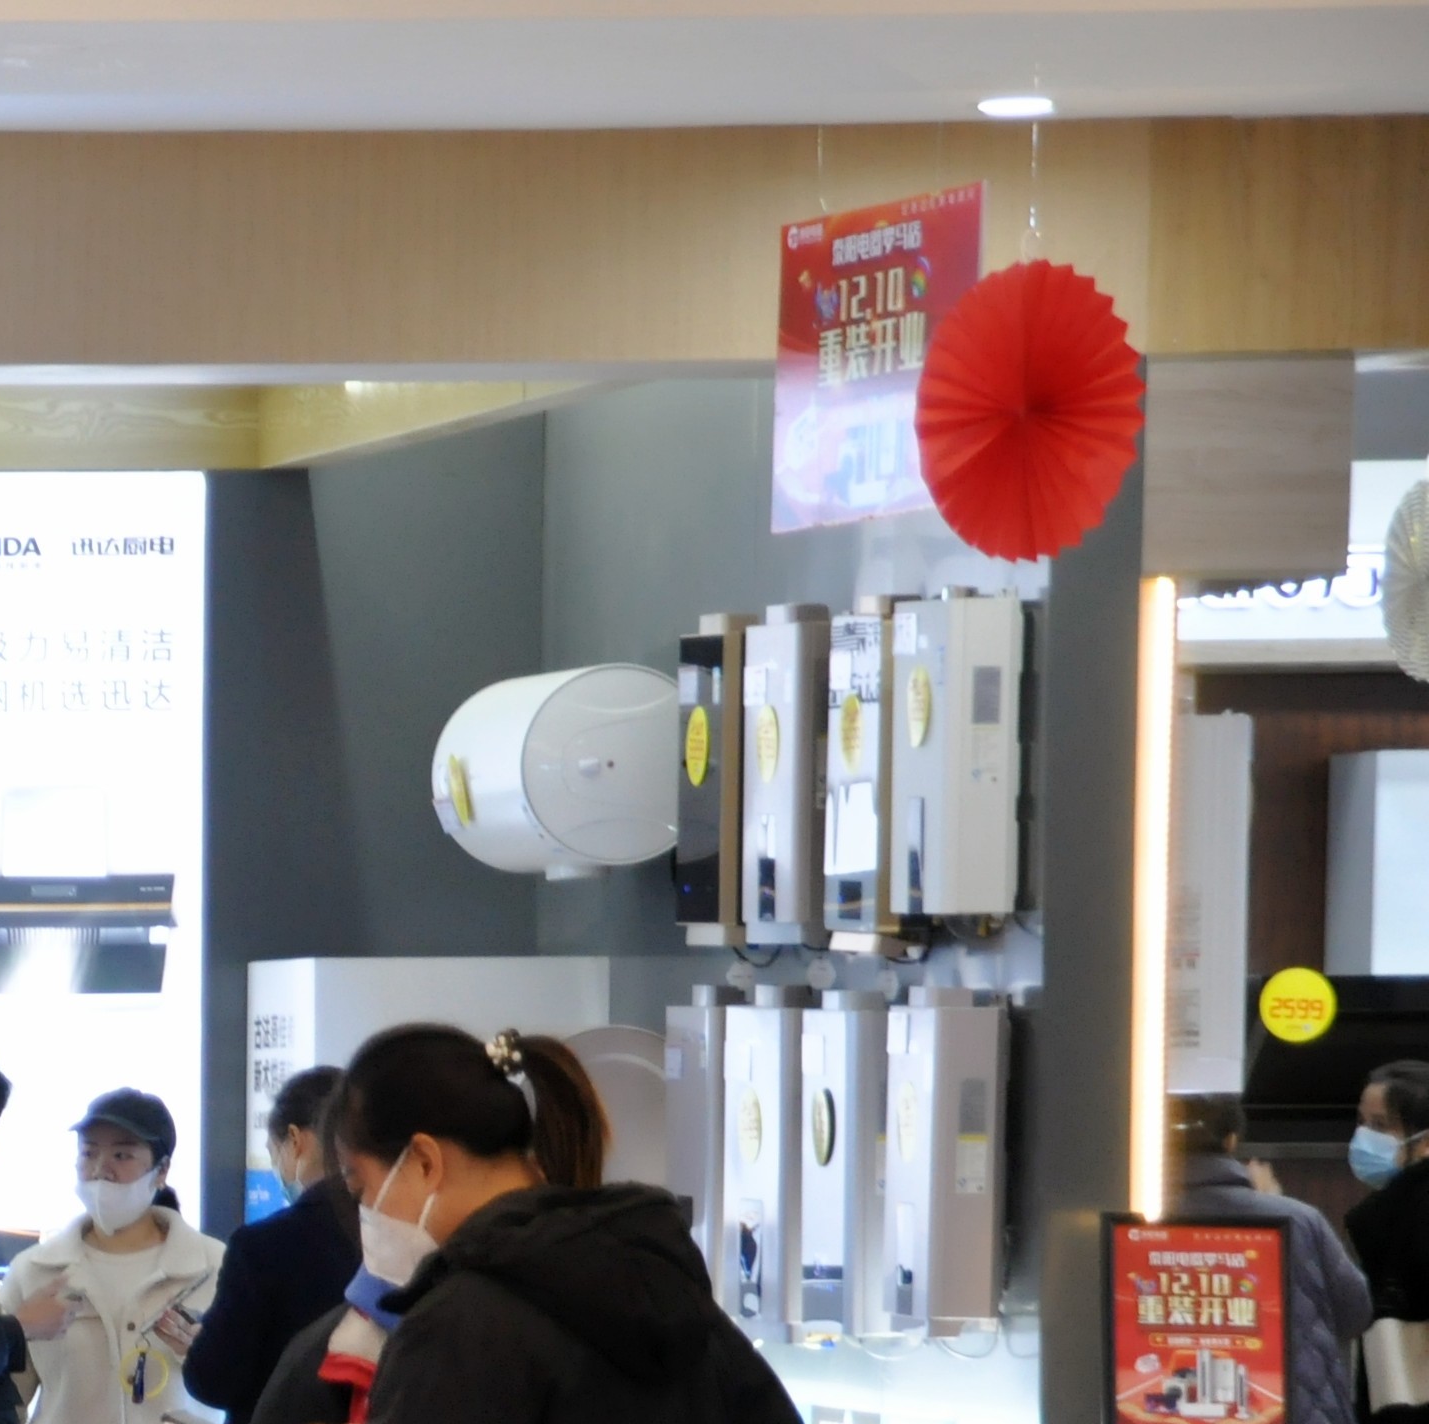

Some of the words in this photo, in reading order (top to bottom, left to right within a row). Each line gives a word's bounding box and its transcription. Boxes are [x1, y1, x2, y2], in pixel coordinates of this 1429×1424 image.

[838, 266, 905, 321] 12.10
[817, 311, 927, 386] 重装开业
[71, 536, 175, 556] 迅达厨电
[1269, 998, 1325, 1020] 2599
[1158, 1272, 1231, 1296] 12.10
[1138, 1295, 1258, 1327] 重装开业
